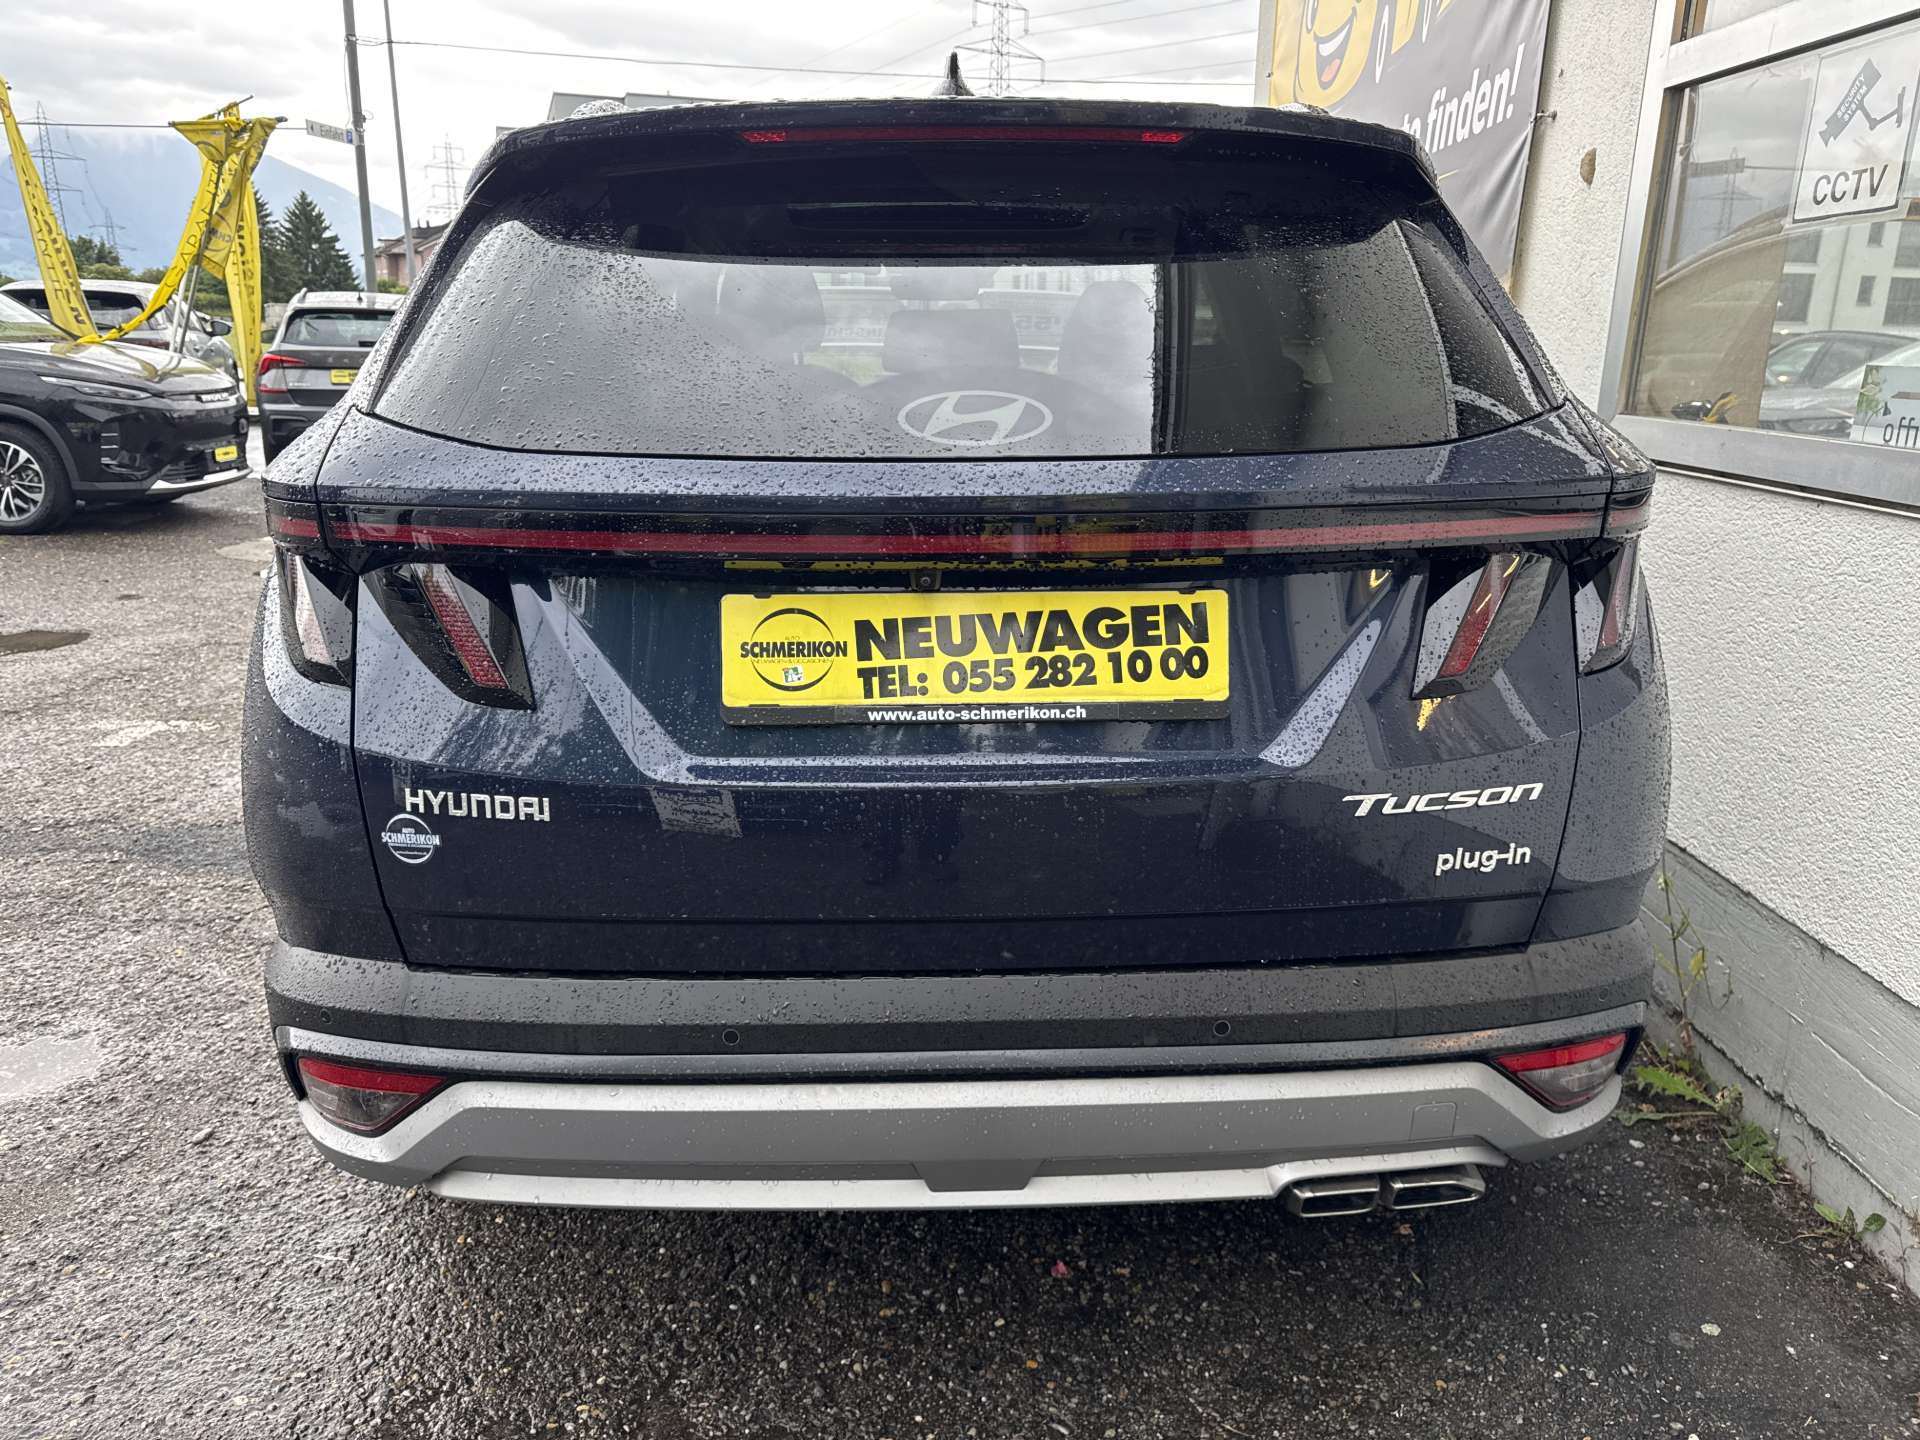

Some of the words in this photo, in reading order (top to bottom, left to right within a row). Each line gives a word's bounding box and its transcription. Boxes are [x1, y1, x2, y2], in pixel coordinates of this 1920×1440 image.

[1424, 42, 1525, 153] finden!
[1836, 73, 1865, 119] SECURITY
[1843, 84, 1868, 122] SYSTEM
[1812, 163, 1889, 206] CCTV
[740, 641, 848, 658] SCHMERIKON
[854, 601, 1210, 661] NEUWAGEN
[857, 664, 928, 699] TEL:
[942, 657, 1016, 694] 055
[1024, 652, 1098, 690] 282
[1107, 648, 1152, 684] 10
[1159, 645, 1210, 681] 00
[868, 705, 1087, 721] www.auto-schmerikon.ch
[404, 787, 550, 822] HYUNDAI
[381, 832, 440, 846] SCHMERIKON
[1434, 843, 1531, 876] plug-in
